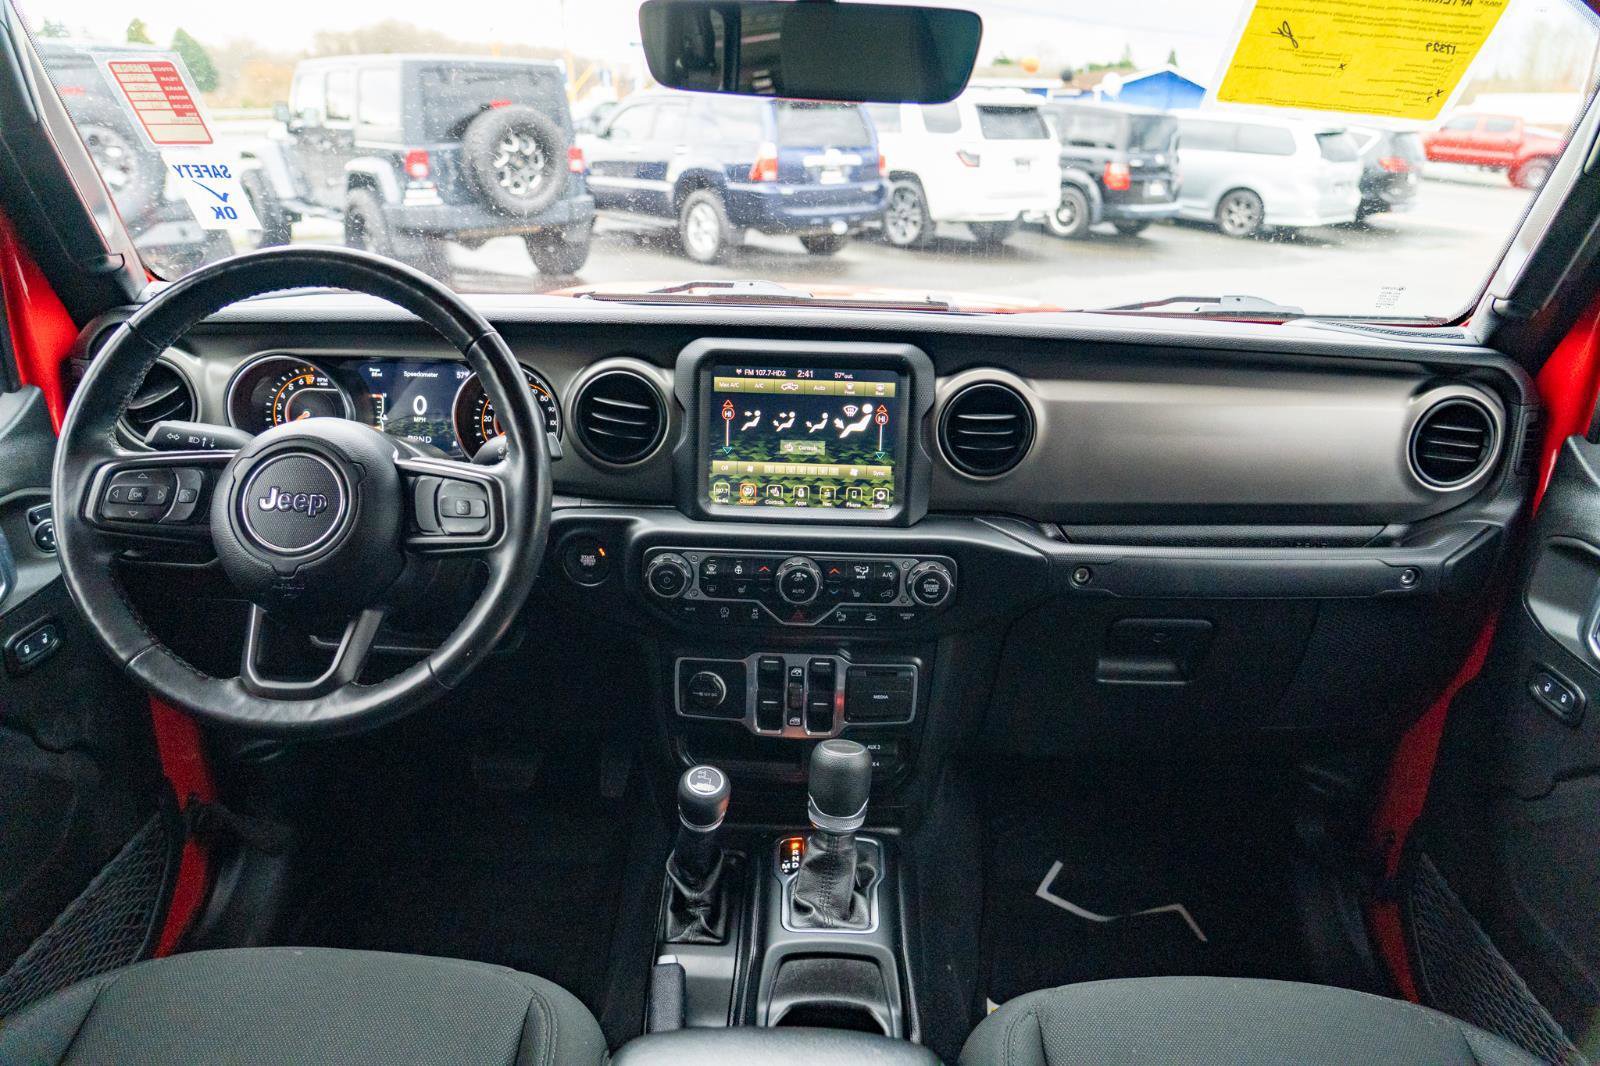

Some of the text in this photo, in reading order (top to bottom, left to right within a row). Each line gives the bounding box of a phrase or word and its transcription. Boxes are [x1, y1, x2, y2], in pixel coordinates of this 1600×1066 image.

[403, 370, 438, 378] Speedometer
[797, 370, 814, 378] 2:41
[288, 383, 294, 391] 5
[276, 402, 282, 410] 3
[413, 395, 427, 415] 0
[276, 414, 282, 422] 2
[258, 486, 328, 517] Jeep
